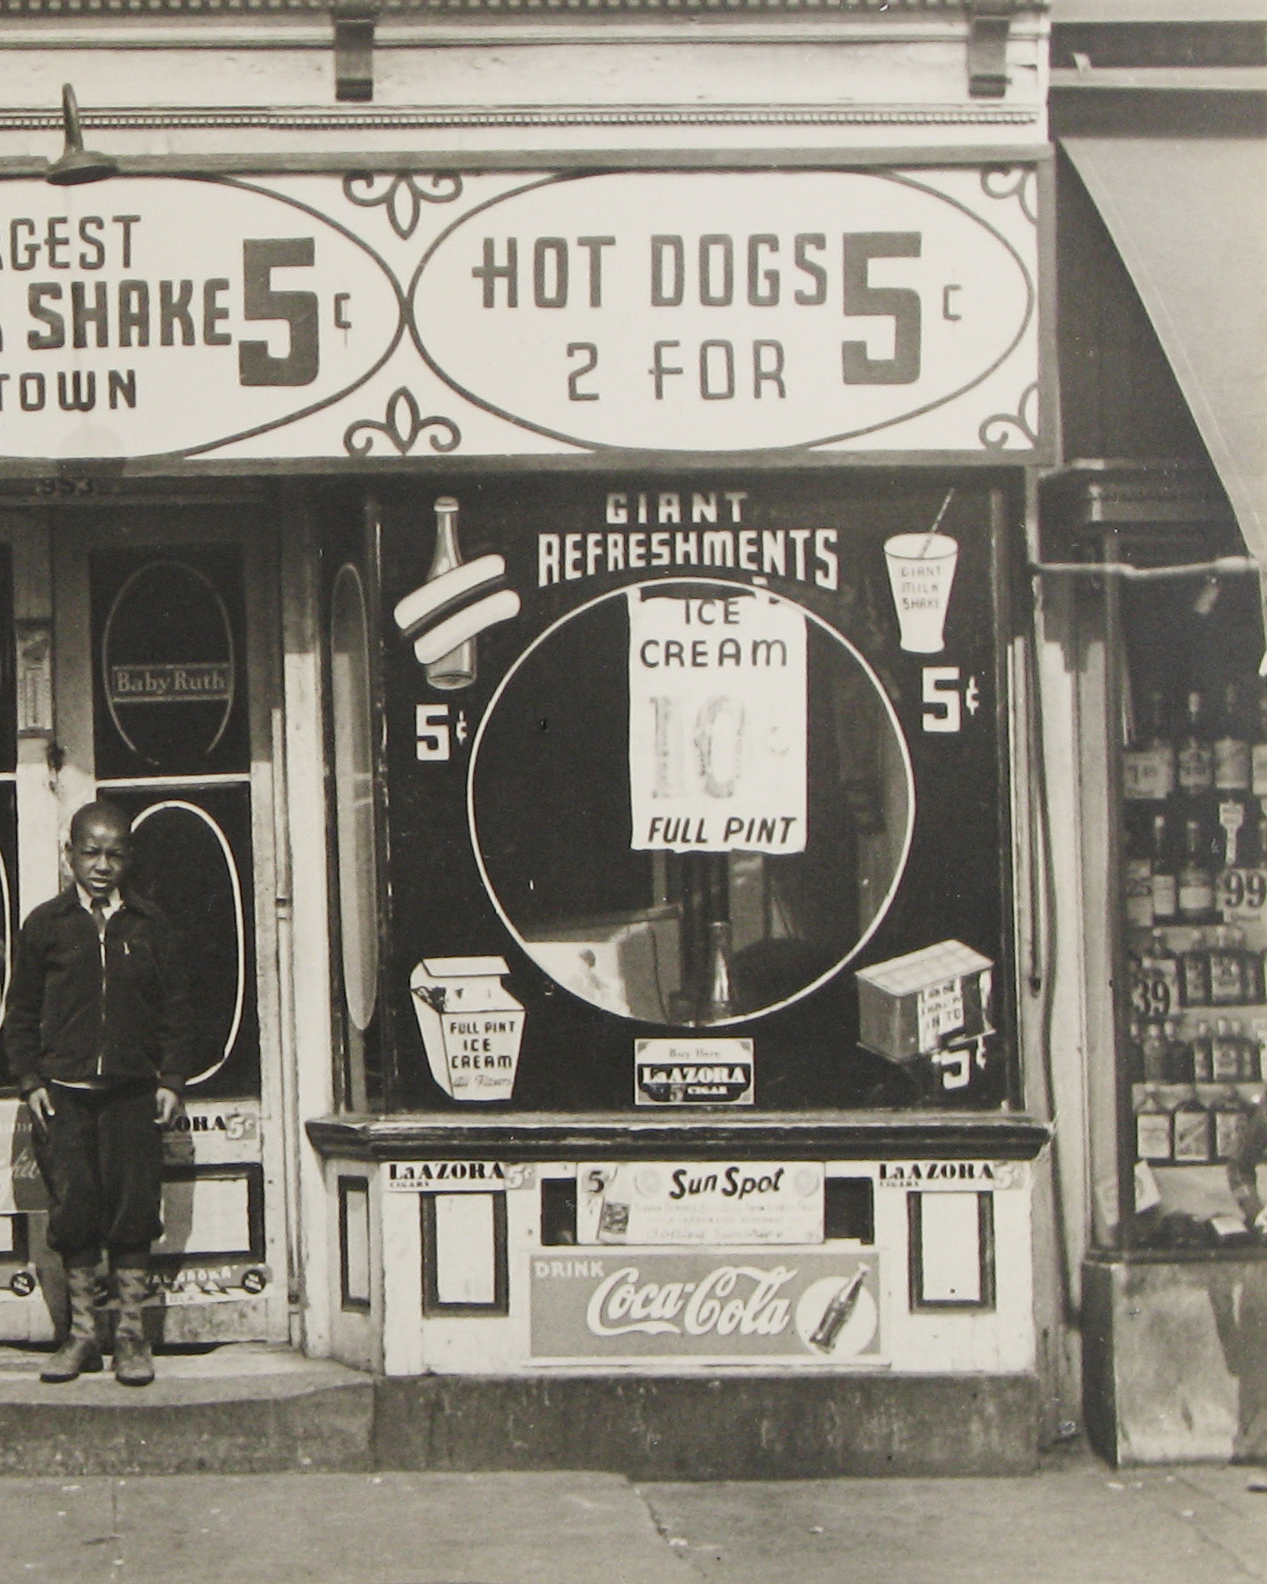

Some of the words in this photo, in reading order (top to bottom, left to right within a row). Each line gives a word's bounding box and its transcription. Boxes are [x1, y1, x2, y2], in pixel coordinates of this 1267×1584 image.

[472, 235, 616, 309] HOT
[649, 232, 828, 308] DOGS
[27, 277, 232, 350] SHAKE
[565, 341, 601, 402] 2
[648, 338, 787, 401] FOR
[605, 491, 748, 525] GIANT
[538, 527, 838, 591] REFRESHMENTS
[684, 598, 741, 625] ICE
[639, 637, 788, 668] CREAM
[118, 671, 171, 694] Baby
[174, 670, 227, 690] Ruth
[647, 816, 708, 844] FULL
[722, 816, 798, 845] PINT
[449, 1021, 481, 1035] FULL
[483, 1020, 516, 1034] PINT
[462, 1037, 492, 1052] ICE
[450, 1054, 513, 1070] CREAM
[667, 1168, 719, 1200] Sun
[720, 1165, 785, 1201] Spot
[535, 1260, 605, 1279] DRINK
[586, 1264, 799, 1337] Coca-Cola
